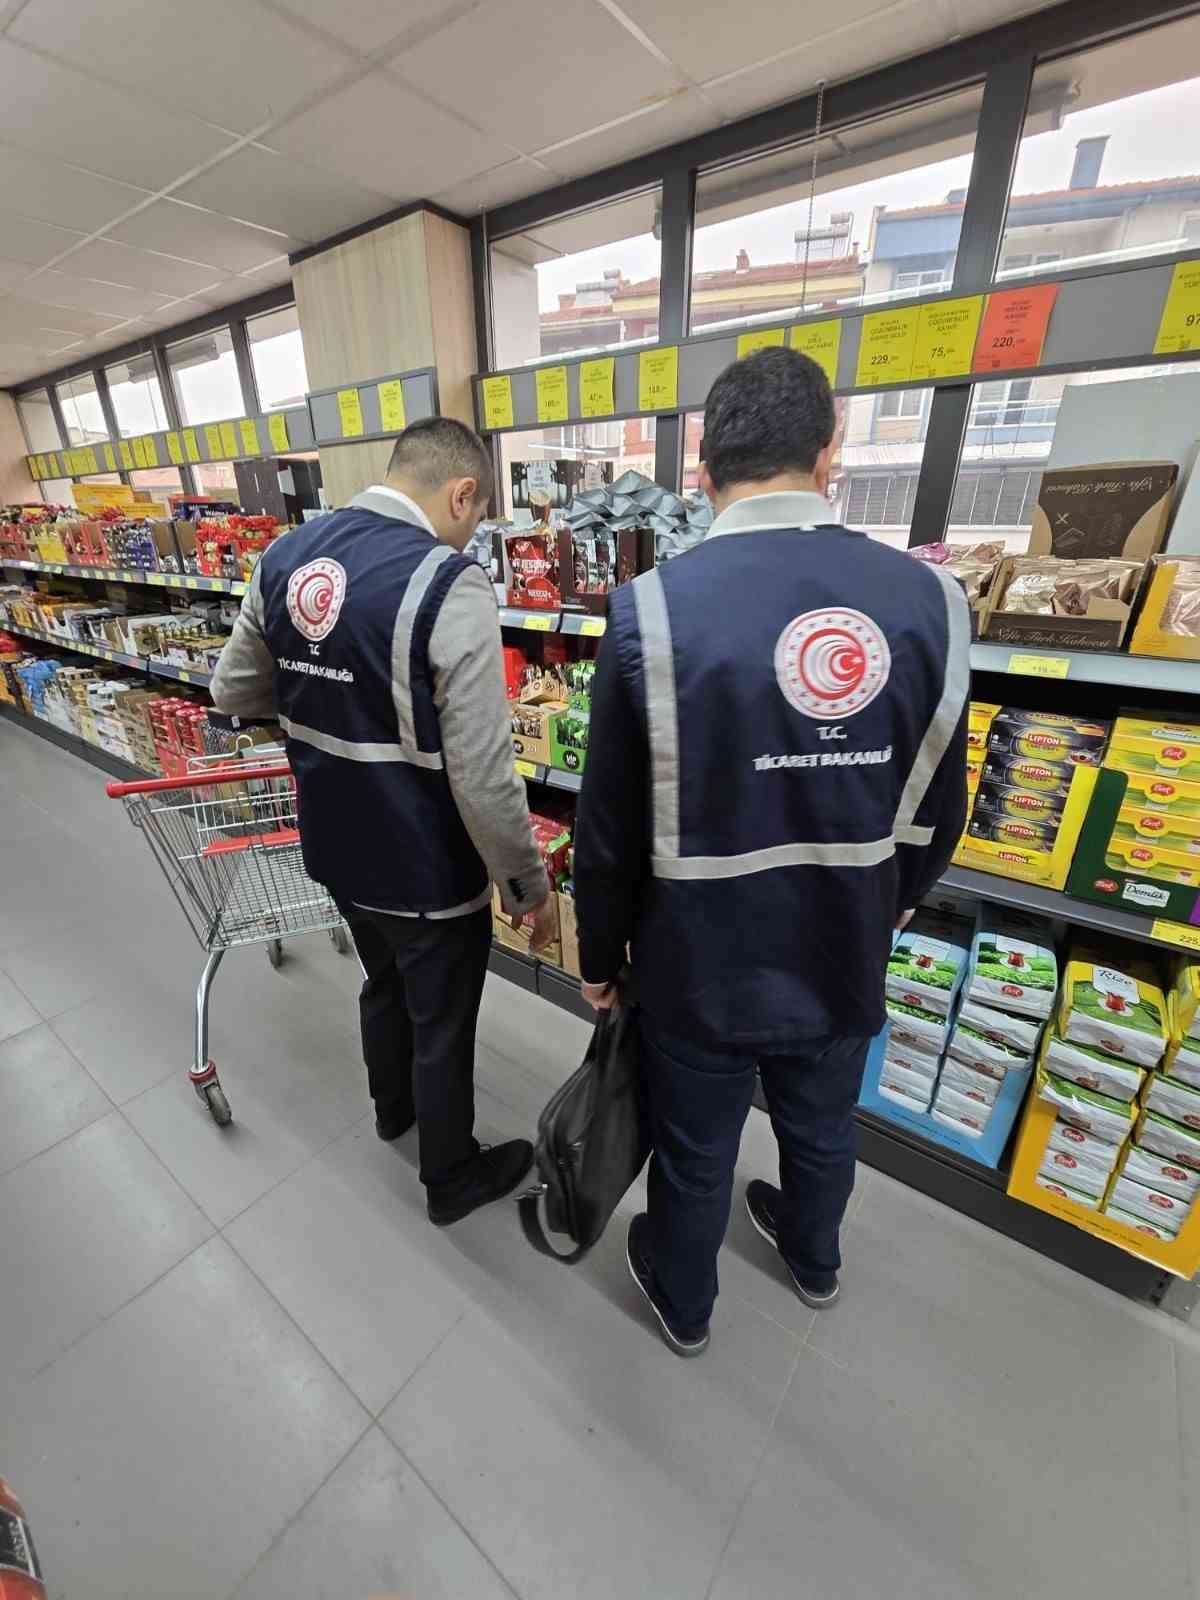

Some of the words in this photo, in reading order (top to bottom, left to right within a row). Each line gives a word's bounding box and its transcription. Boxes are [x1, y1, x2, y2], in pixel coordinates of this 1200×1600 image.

[1028, 734, 1060, 746] LIPTON
[1021, 766, 1052, 777] LIPTON
[1014, 794, 1044, 808] LIPTON
[1007, 824, 1036, 837] LIPTON
[999, 852, 1028, 864] LIPTON
